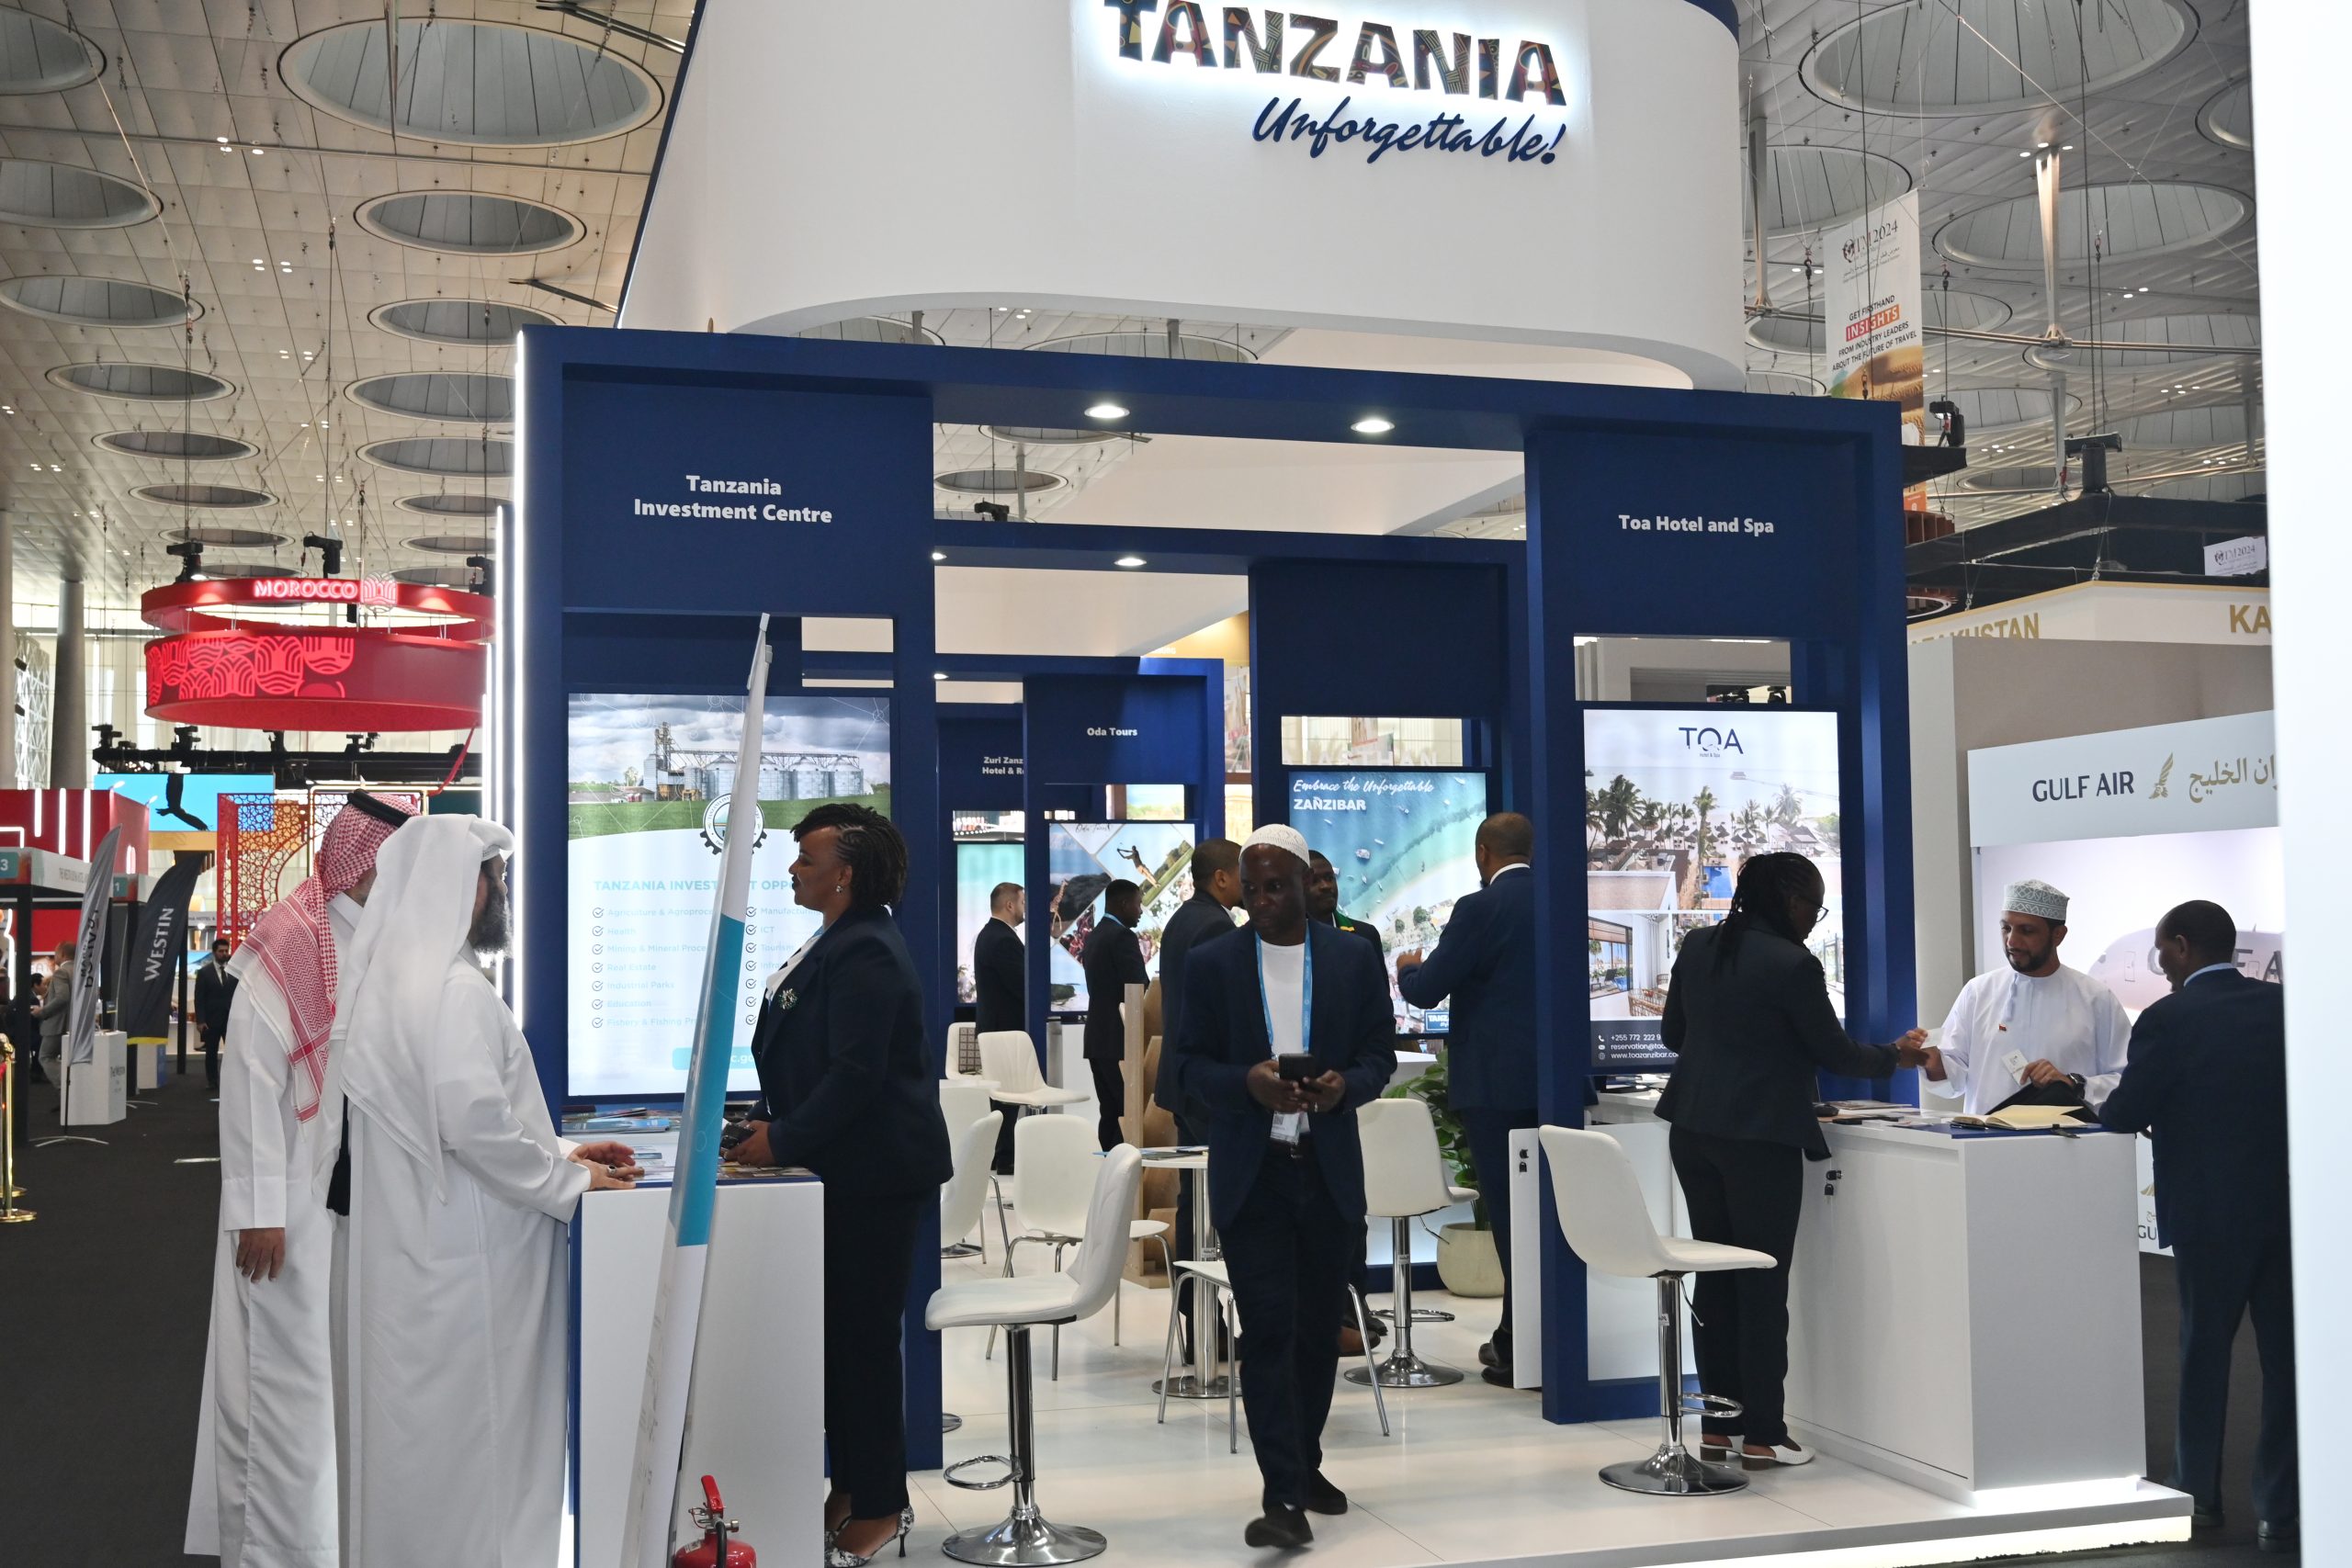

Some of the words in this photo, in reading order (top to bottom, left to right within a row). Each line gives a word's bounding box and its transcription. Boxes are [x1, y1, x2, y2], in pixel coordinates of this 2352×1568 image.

[1104, 0, 1567, 106] TANZANIA
[1252, 96, 1567, 164] Unforgettable!
[1873, 219, 1898, 243] 2024
[1849, 310, 1860, 321] GET
[1861, 295, 1895, 316] FIRSTHAND
[1847, 306, 1898, 340] INSIGHTS
[1838, 345, 1854, 357] FROM
[1856, 333, 1882, 349] INDUSTRY
[1883, 321, 1909, 337] LEADERS
[1832, 358, 1850, 371] ABOUT
[1851, 353, 1864, 363] THE
[1862, 344, 1884, 359] FUTURE
[1885, 340, 1894, 349] OF
[1894, 331, 1917, 345] TRAVEL
[685, 475, 782, 496] Tanzania
[634, 499, 757, 520] Investment
[763, 504, 832, 524] Centre
[1618, 514, 1651, 530] Toa
[1656, 515, 1703, 531] Hotel
[1707, 517, 1739, 533] and
[1744, 518, 1774, 536] Spa
[254, 580, 357, 599] MOROCCO
[1087, 727, 1107, 737] Oda
[1109, 728, 1138, 737] Tours
[1679, 727, 1744, 754] TOA
[983, 756, 1001, 764] Zuri
[982, 766, 1006, 774] Hotel
[1007, 766, 1014, 774] &
[1293, 779, 1340, 792] Embrace
[1342, 776, 1361, 792] the
[1363, 779, 1435, 795] Unforgettable
[2032, 775, 2090, 802] GULF
[2096, 771, 2134, 797] AIR
[2188, 757, 2247, 804] الخليج
[594, 880, 666, 891] TANZANIA
[670, 880, 757, 891] INVESTT
[607, 908, 657, 919] Agriculture
[659, 908, 665, 917] &
[607, 927, 637, 935] Health
[761, 926, 775, 934] ICT
[144, 908, 175, 982] WESTIN
[607, 945, 636, 954] Mining
[639, 945, 646, 953] &
[648, 944, 680, 953] Mineral
[761, 943, 794, 952] Tourism
[607, 964, 626, 972] Real
[629, 963, 656, 972] Estate
[607, 982, 649, 990] Industrial
[650, 981, 675, 989] Parks
[607, 999, 651, 1009] Education
[650, 1018, 682, 1028] Fishing
